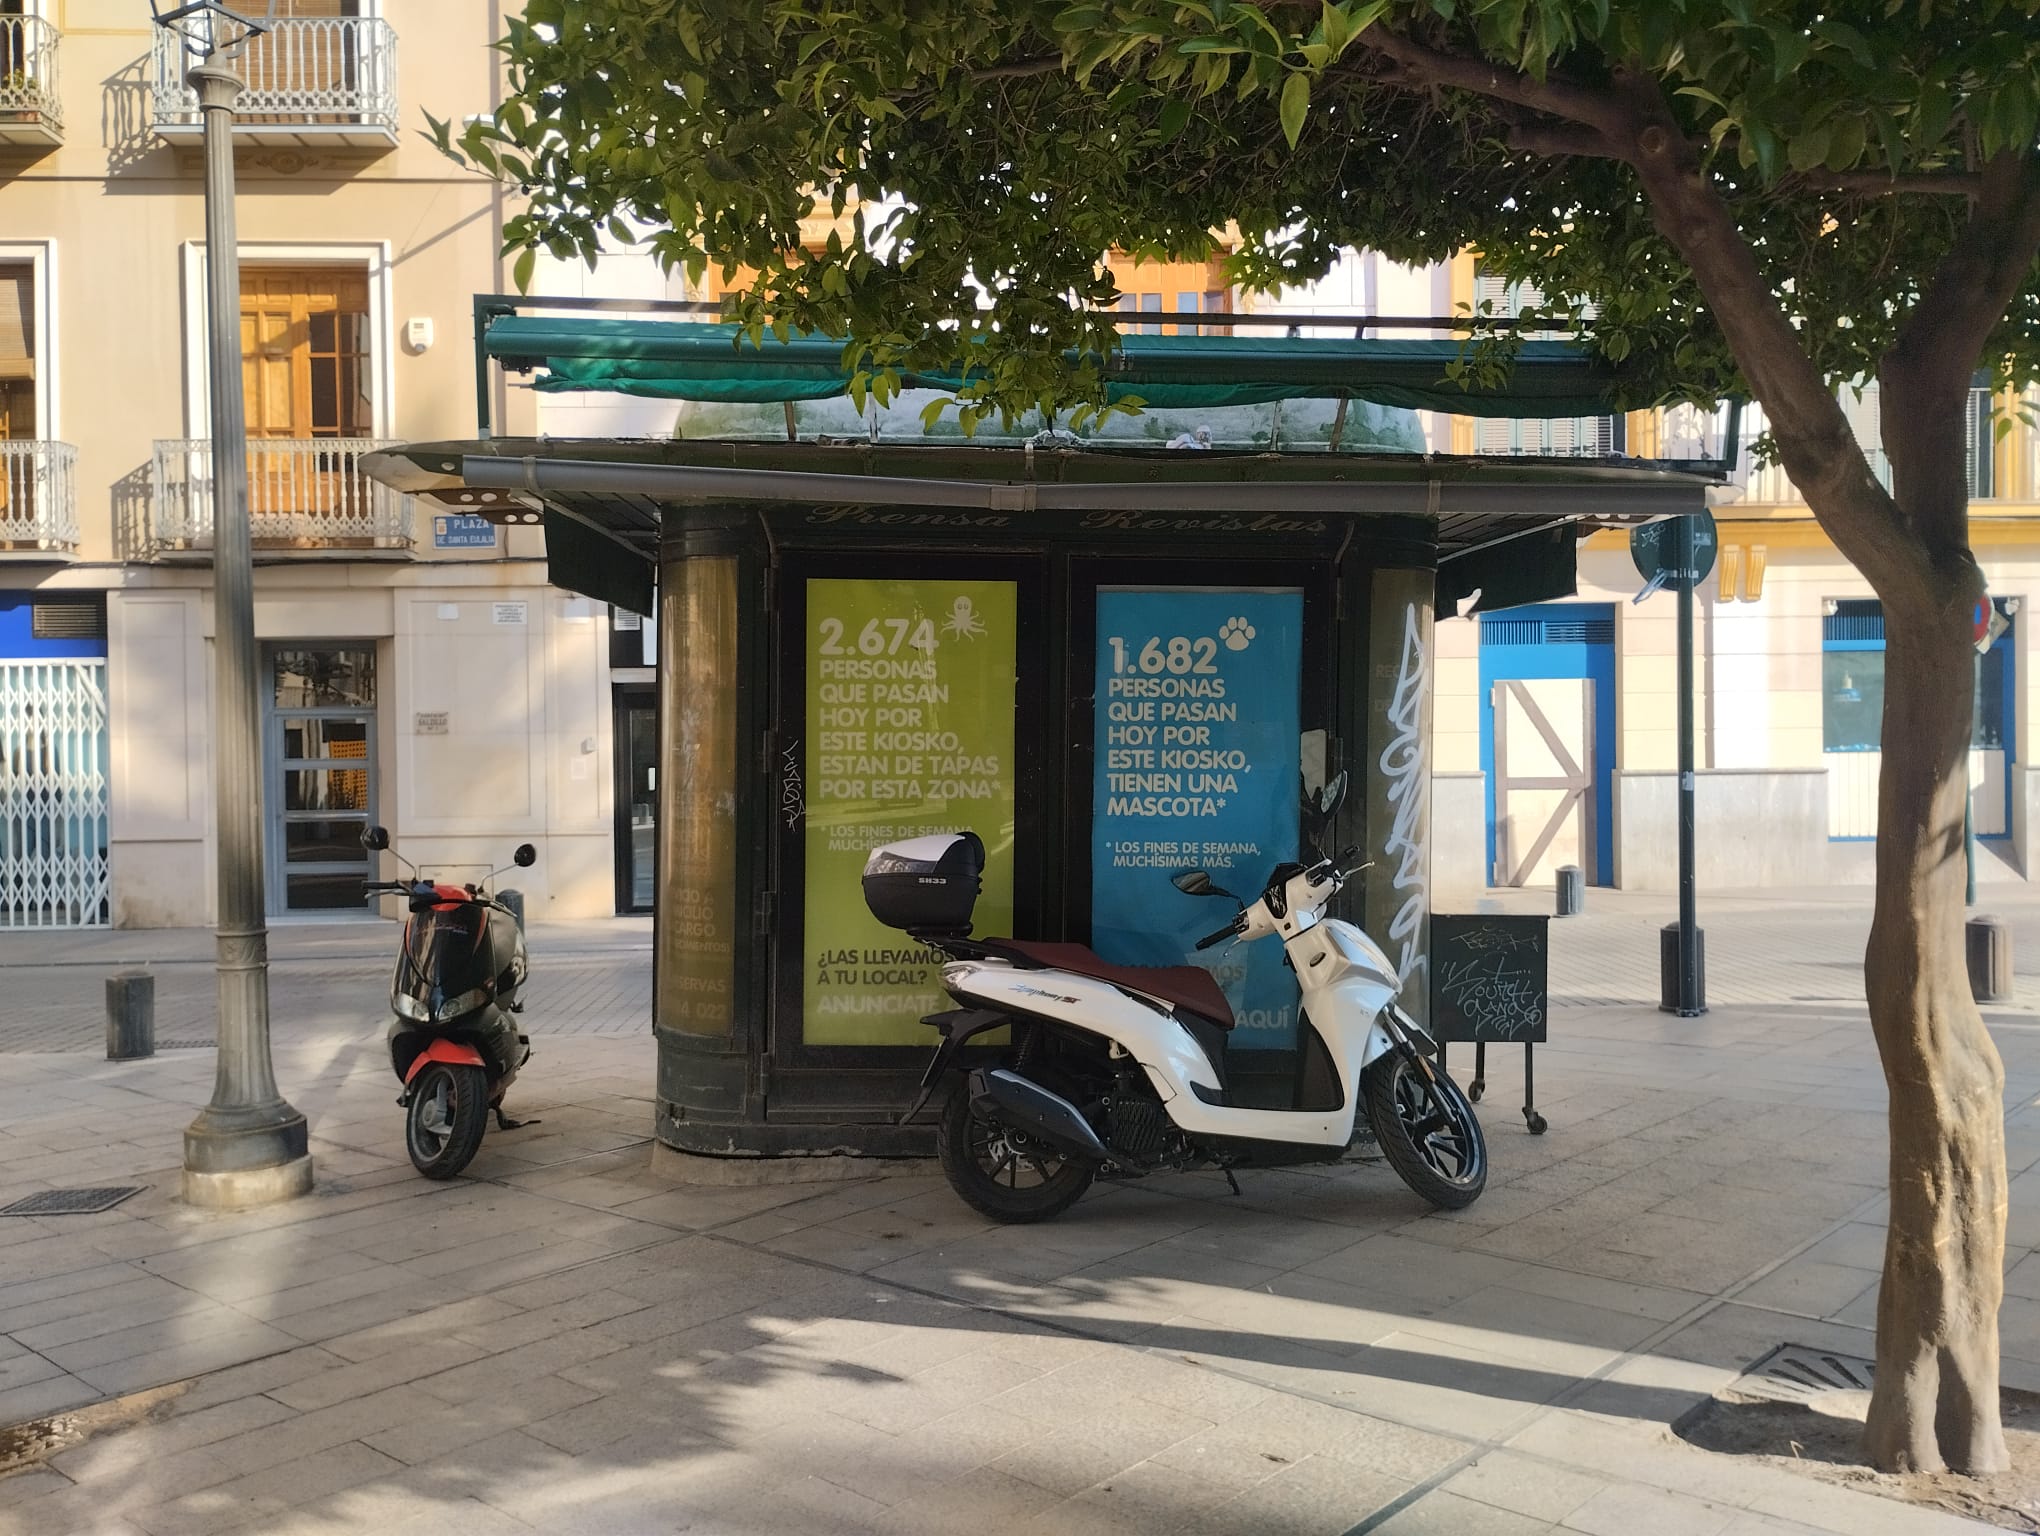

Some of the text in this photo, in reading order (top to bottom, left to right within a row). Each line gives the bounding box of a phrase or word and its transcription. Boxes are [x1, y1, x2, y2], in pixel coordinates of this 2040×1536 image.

[454, 519, 490, 529] PLAZA
[805, 502, 1010, 527] Prensa
[1079, 509, 1327, 532] Revistas
[436, 536, 446, 544] DE
[819, 617, 940, 656] 2.674
[1108, 636, 1218, 675] 1.682
[819, 659, 937, 680] PERSONAS
[819, 683, 949, 704] QUE PASAN
[1108, 678, 1226, 698] PERSONAS
[819, 708, 922, 727] HOY POR
[1108, 702, 1237, 722] QUE PASAN
[819, 731, 964, 755] ESTE KIOSKO,
[1108, 726, 1210, 746] HOY POR
[819, 756, 999, 775] ESTAN DE TAPAS
[1108, 750, 1252, 773] ESTE KIOSKO,
[819, 780, 865, 799] POR
[871, 780, 923, 799] ESTA
[1107, 773, 1238, 793] TIENEN UNA
[830, 825, 855, 837] LOS
[859, 825, 893, 838] FINES
[897, 825, 915, 838] DE
[1115, 842, 1261, 856] LOS FINES DE SEMANA,
[1113, 852, 1236, 868] MUCHÍSIMAS MÁS.
[817, 949, 858, 968] ¿LAS
[817, 970, 928, 985] A TU LOCAL?
[1235, 1004, 1290, 1029] AQUÍ
